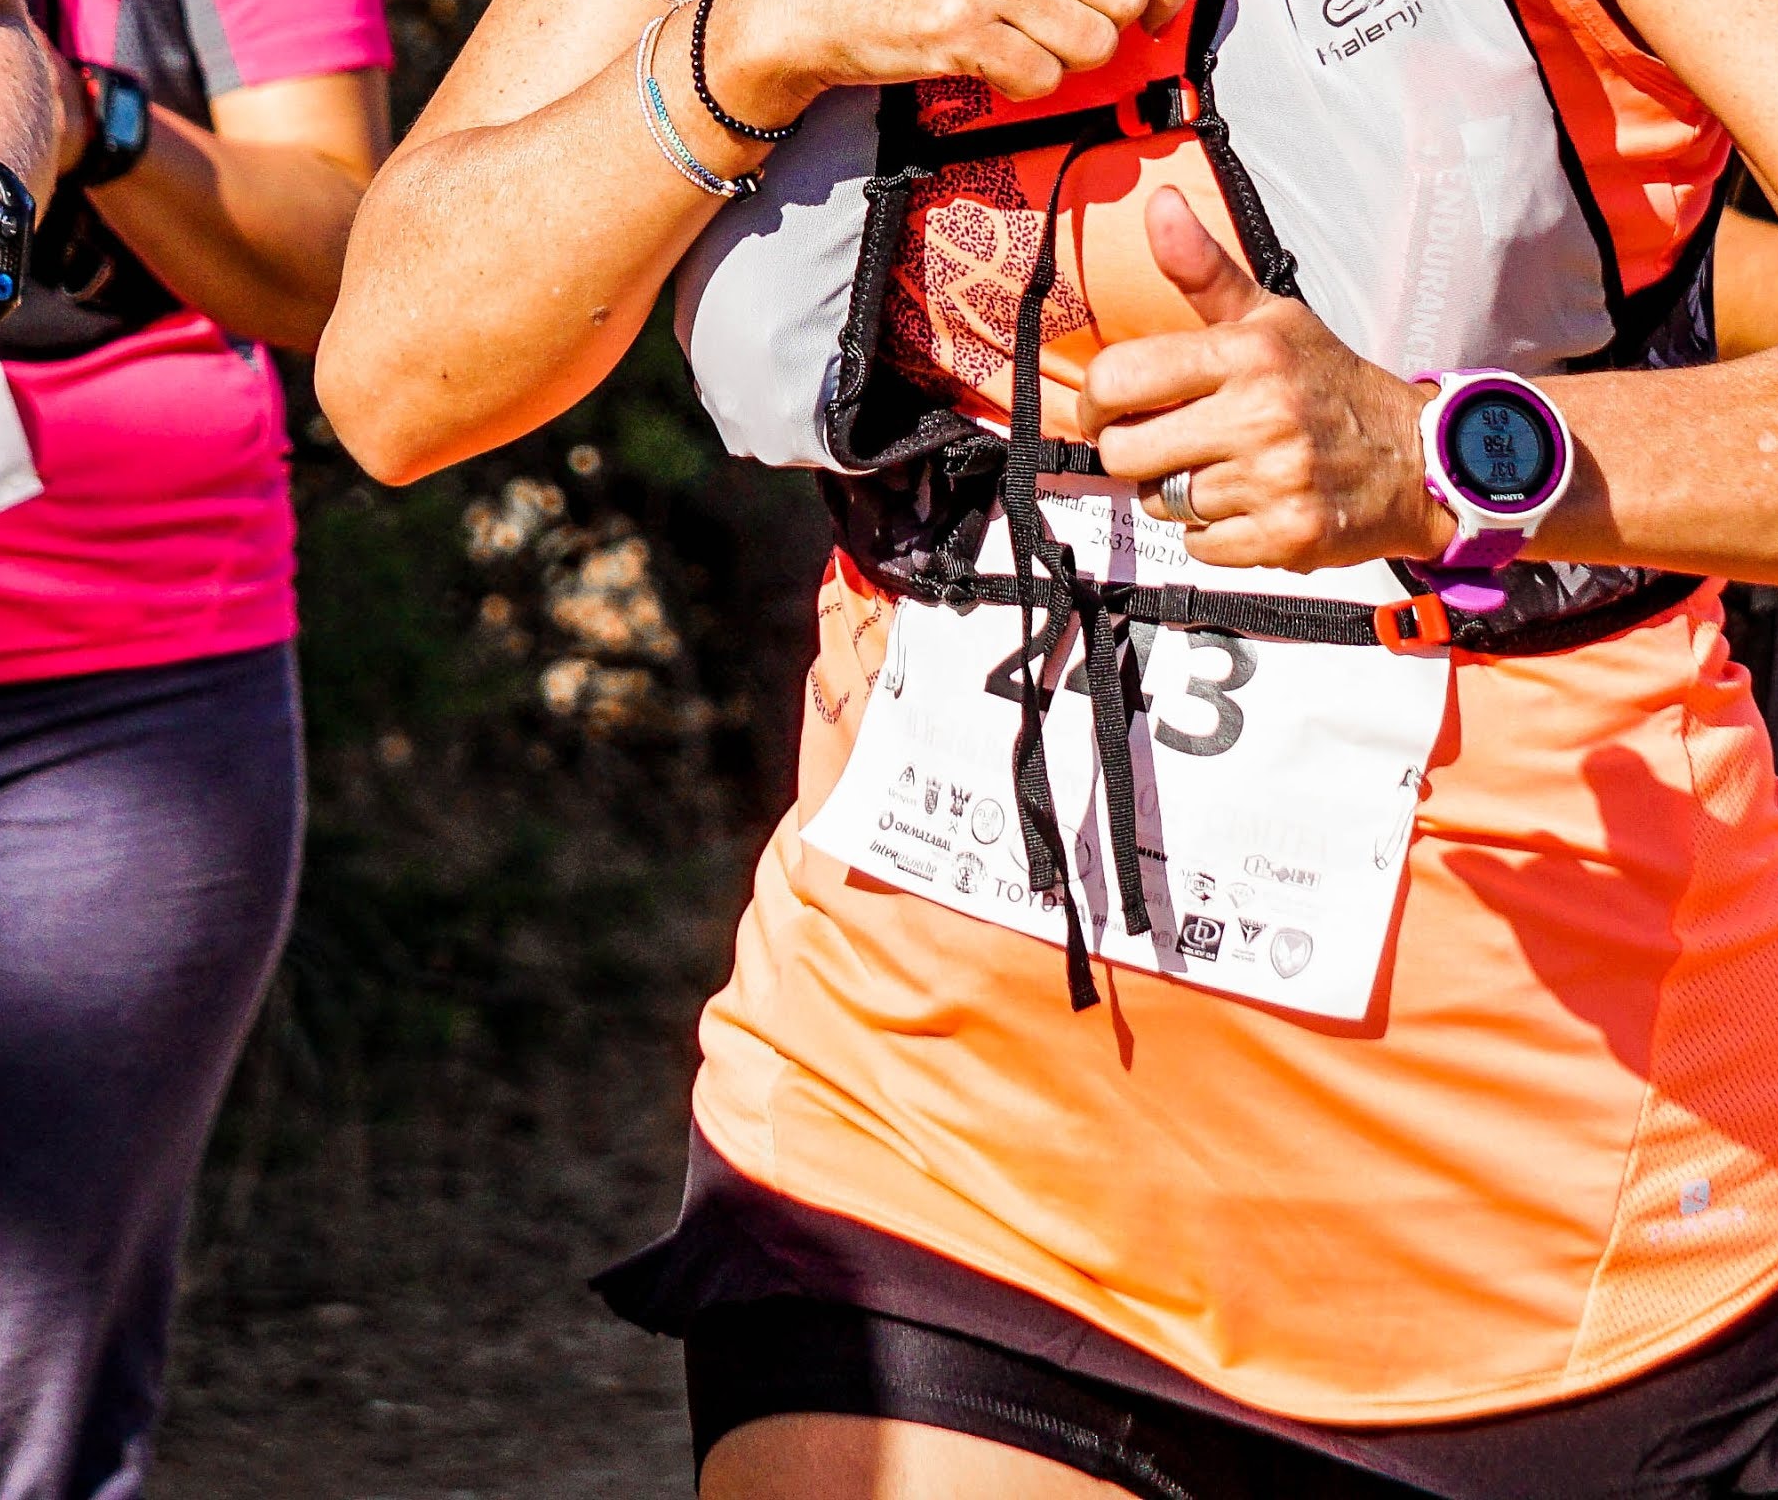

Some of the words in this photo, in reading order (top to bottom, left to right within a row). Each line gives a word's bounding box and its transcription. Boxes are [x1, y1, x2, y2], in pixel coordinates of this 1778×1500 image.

[1033, 486, 1088, 514] ontatar
[1091, 501, 1117, 523] em
[1121, 511, 1161, 535] caso
[1089, 526, 1190, 568] 263740219
[894, 820, 952, 853] ORMAZABAL
